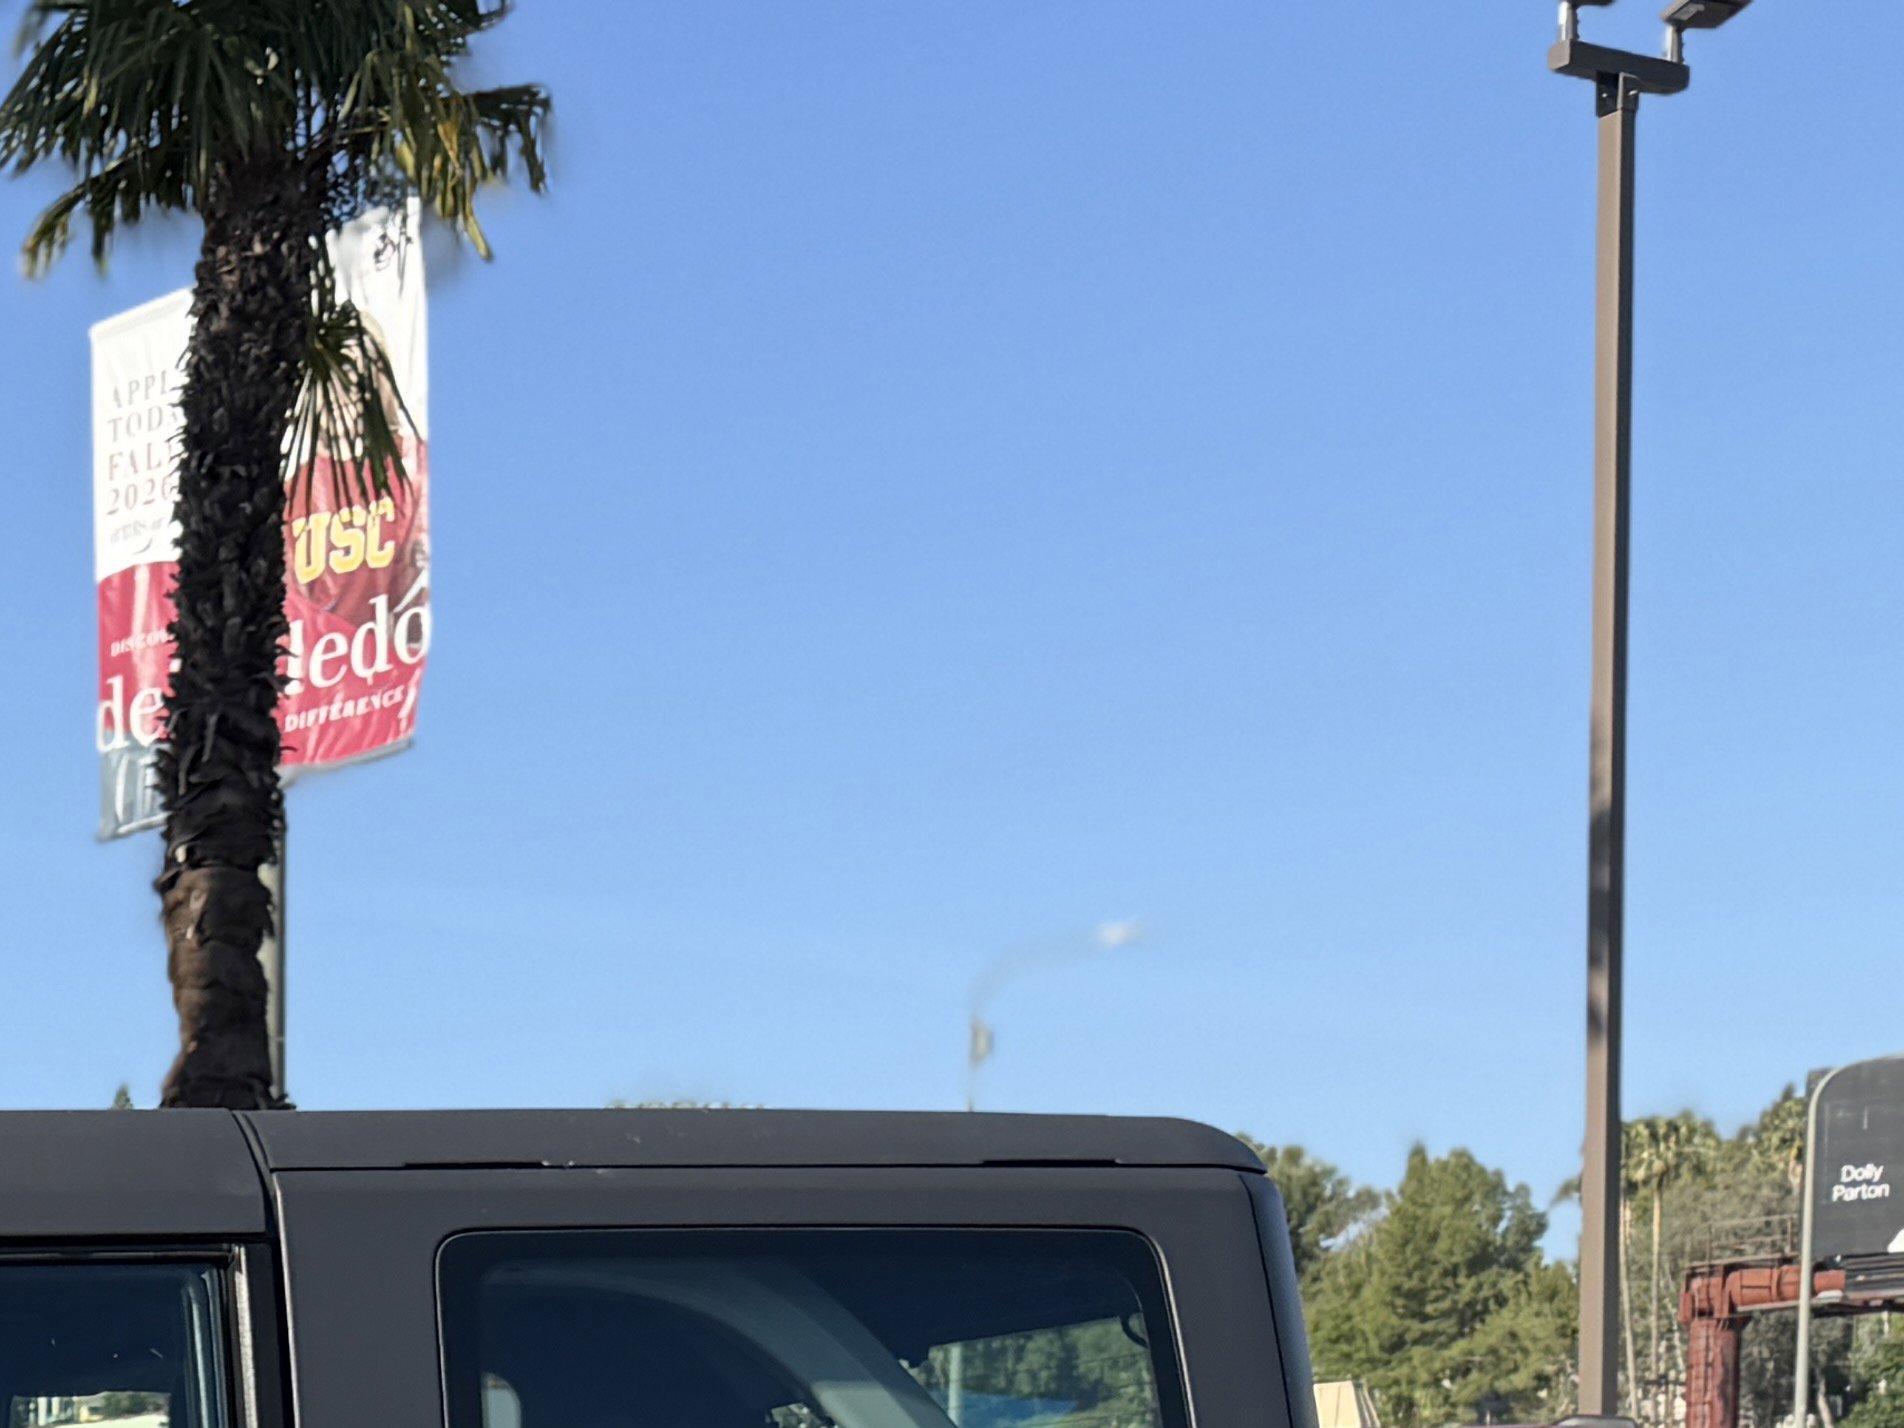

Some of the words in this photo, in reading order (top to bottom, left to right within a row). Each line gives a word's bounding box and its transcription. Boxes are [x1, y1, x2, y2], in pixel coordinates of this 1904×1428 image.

[112, 369, 169, 409] APPL
[106, 404, 178, 443] TOD
[291, 497, 396, 584] USC
[1832, 1183, 1891, 1203] Parton
[1839, 1163, 1885, 1184] Dolly
